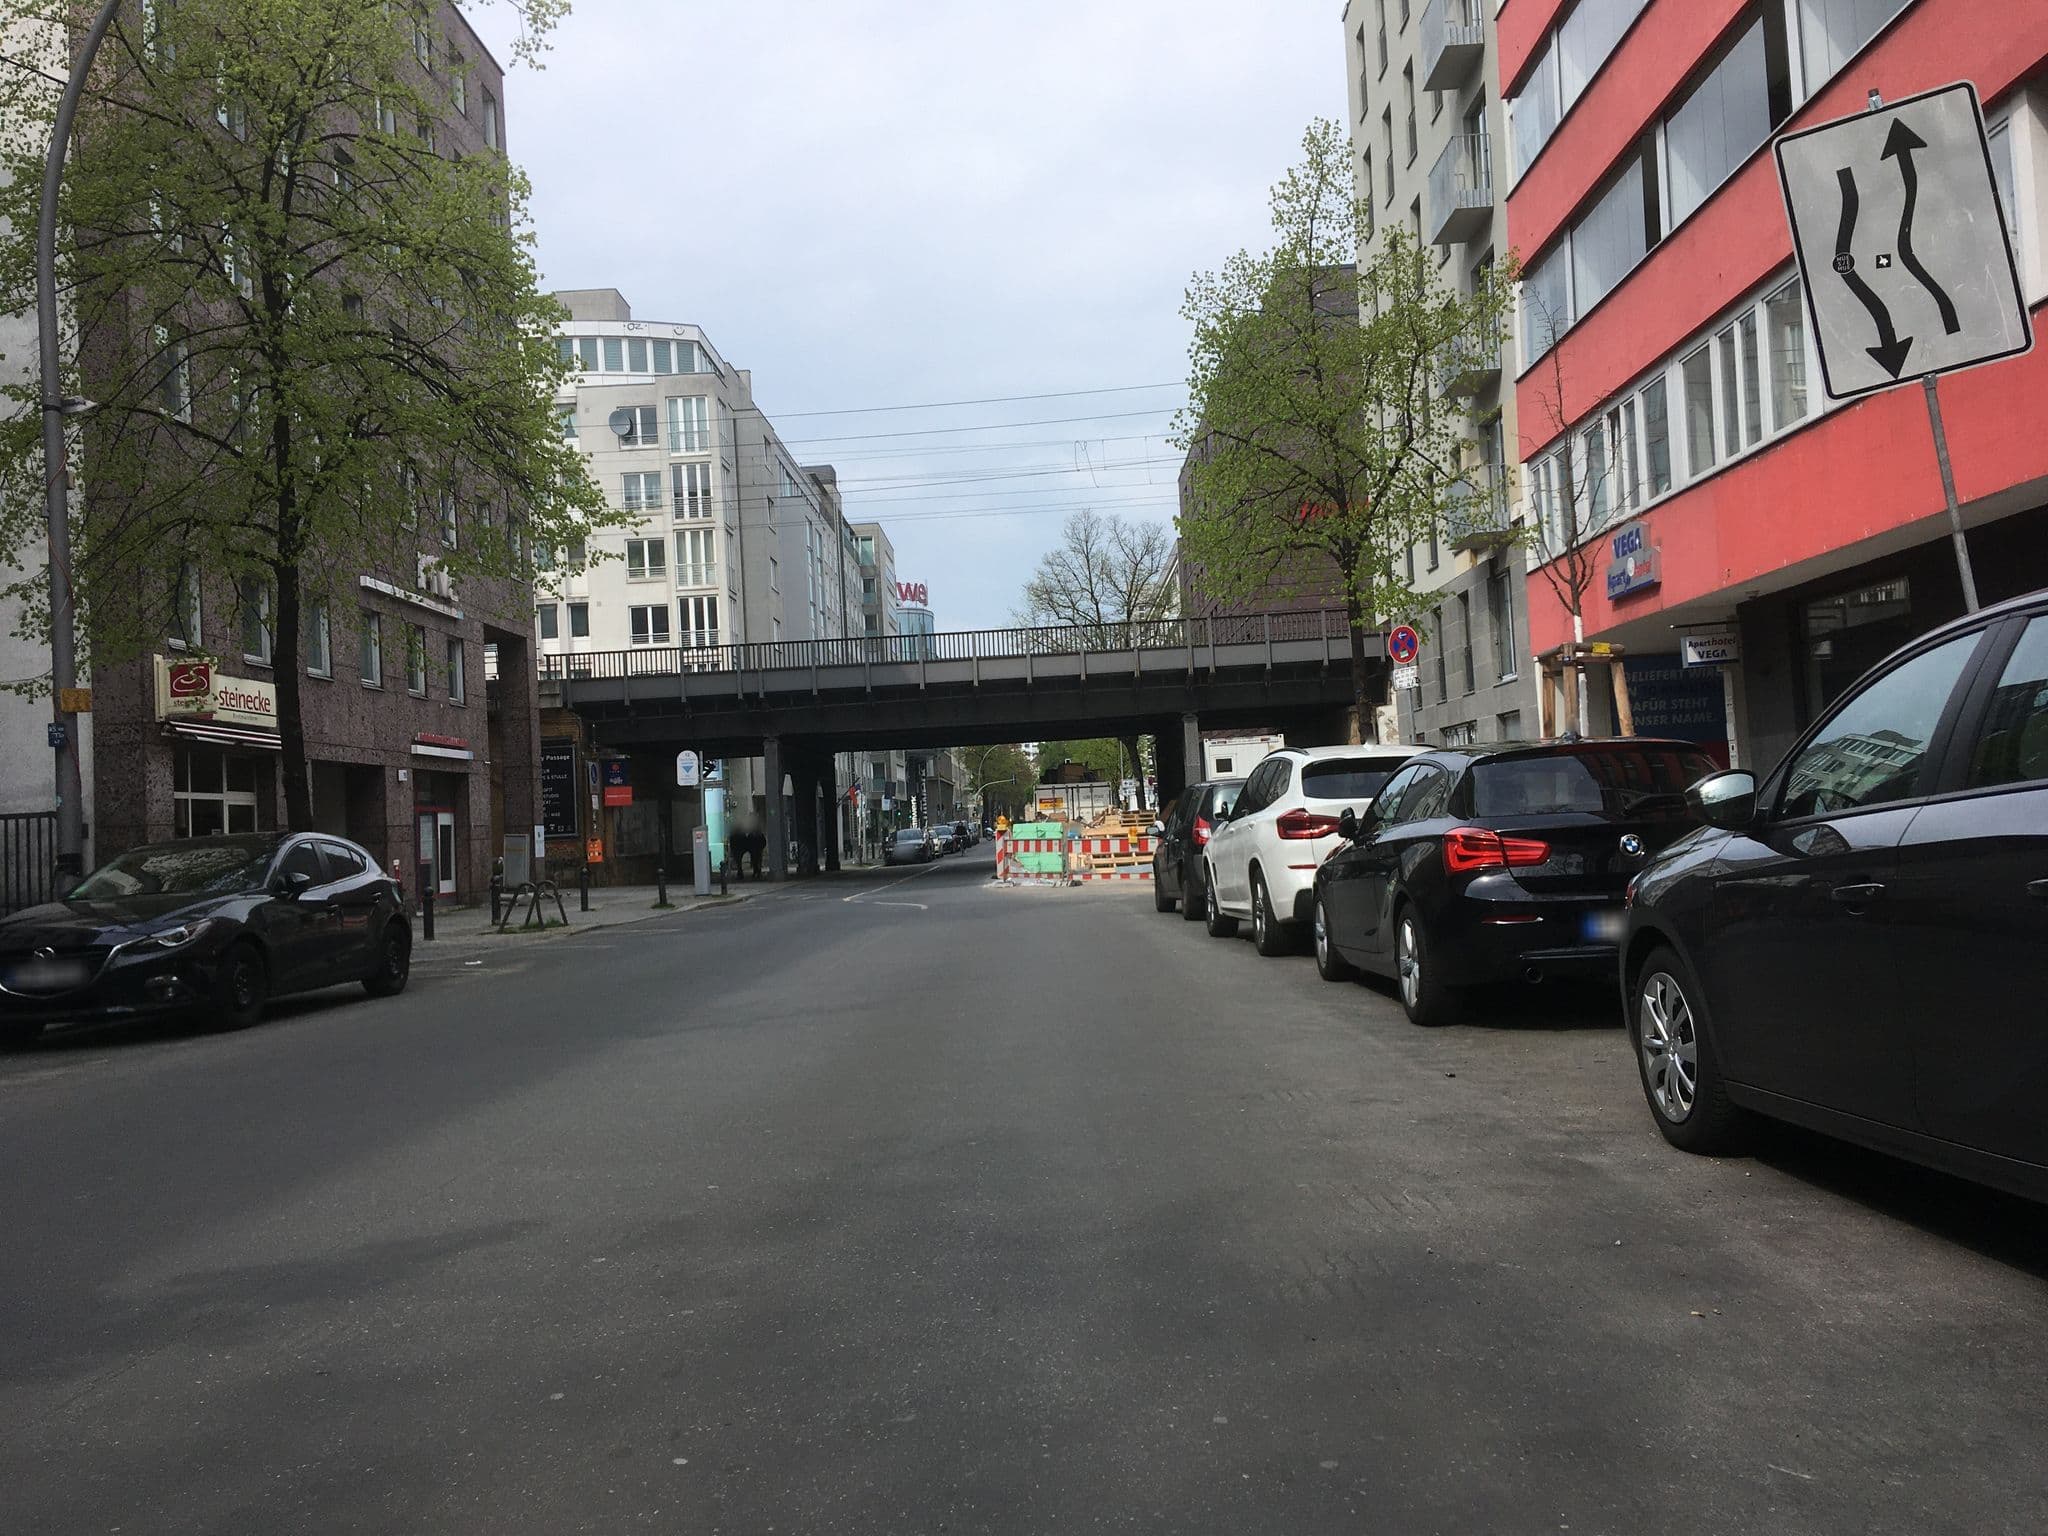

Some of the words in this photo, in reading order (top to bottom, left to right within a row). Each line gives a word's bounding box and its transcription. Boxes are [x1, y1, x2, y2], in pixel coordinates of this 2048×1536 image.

[1613, 528, 1642, 559] VEGA
[1688, 636, 1736, 648] Aparthotel
[1698, 650, 1728, 659] VEGA
[219, 687, 270, 712] steinecke
[1632, 697, 1666, 712] AFÜR
[1634, 714, 1668, 726] NSER
